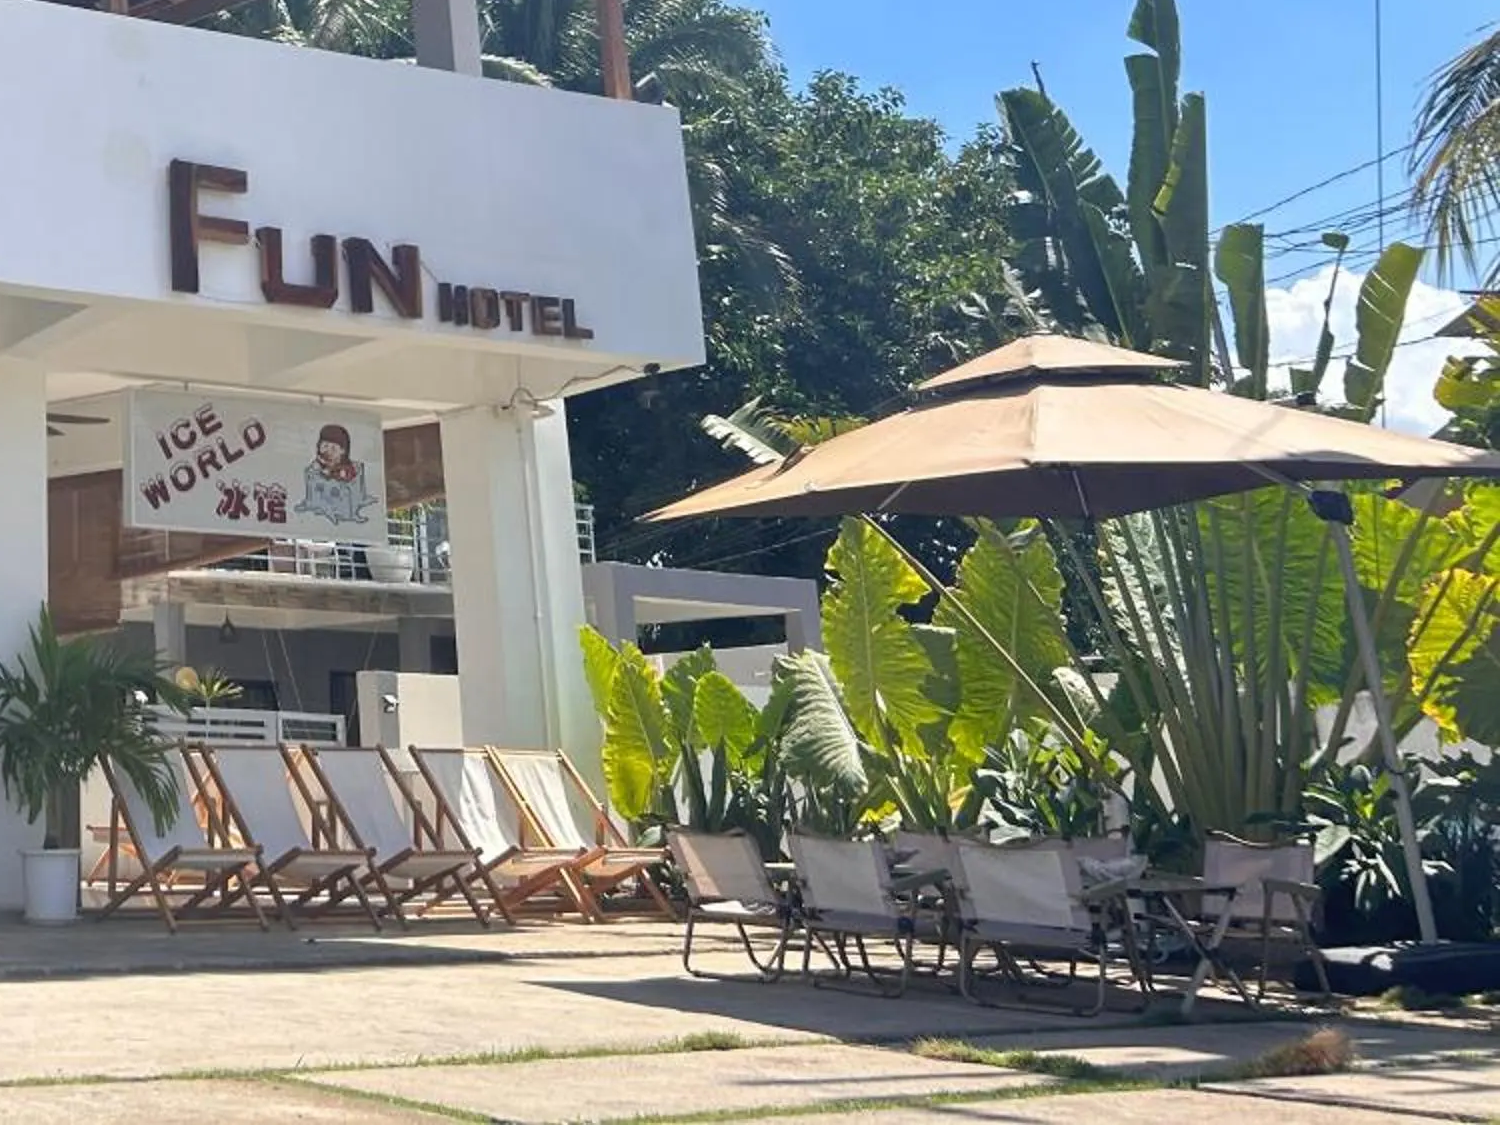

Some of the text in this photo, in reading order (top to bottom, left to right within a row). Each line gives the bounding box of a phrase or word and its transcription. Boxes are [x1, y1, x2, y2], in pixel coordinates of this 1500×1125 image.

[438, 282, 594, 340] HOTEL
[155, 401, 224, 460] ICE
[139, 416, 267, 510] WORLD
[215, 478, 288, 524] 冰馆
